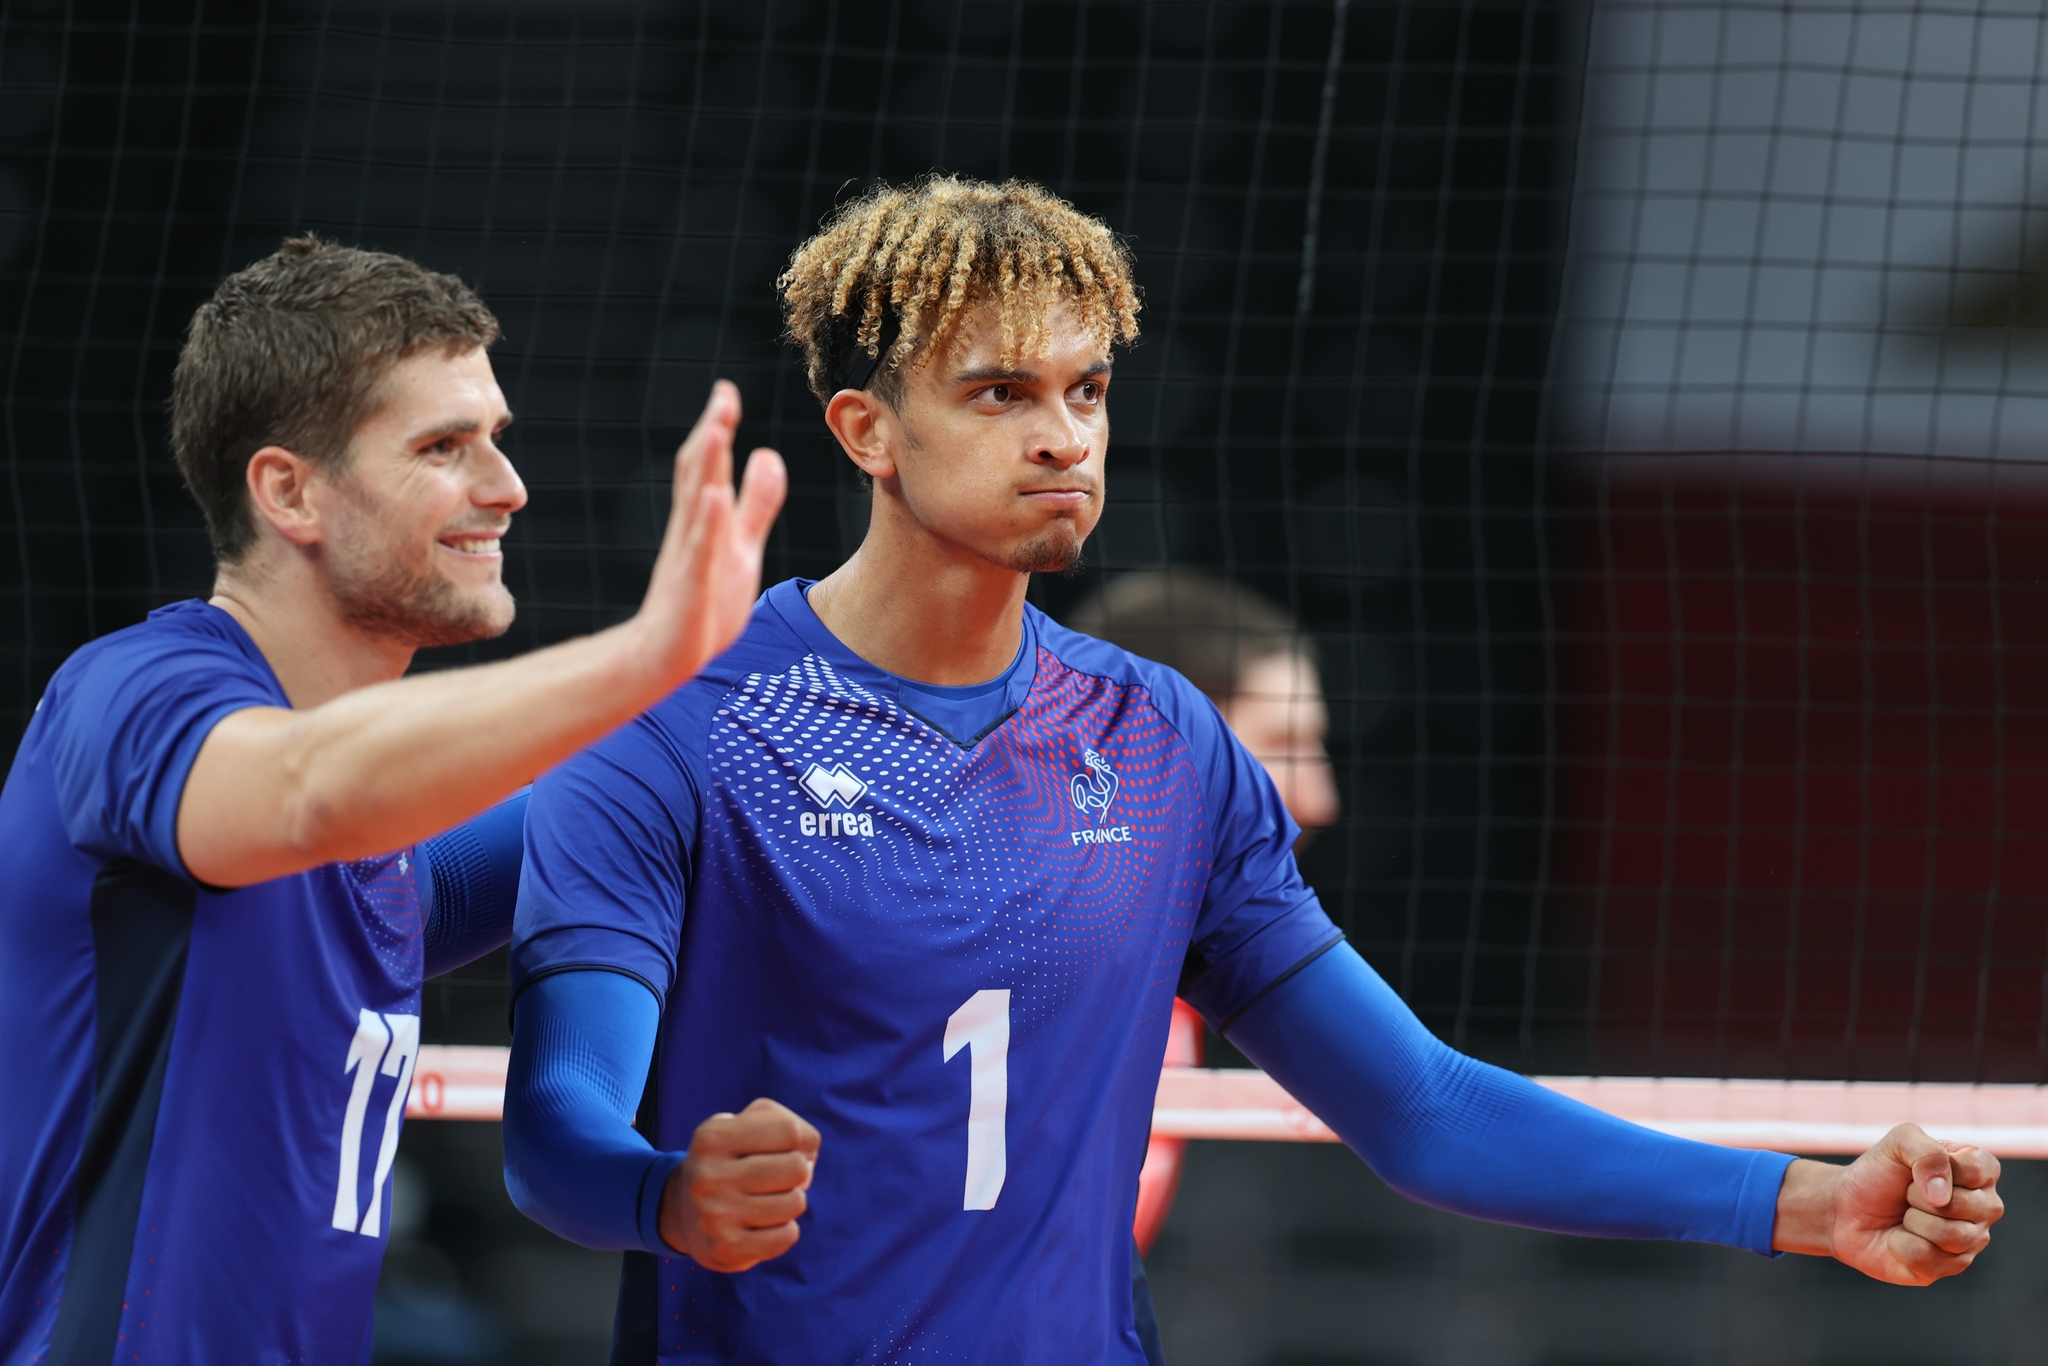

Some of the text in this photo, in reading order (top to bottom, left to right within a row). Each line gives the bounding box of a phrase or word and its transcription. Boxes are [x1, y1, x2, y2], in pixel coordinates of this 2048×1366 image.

[1071, 826, 1132, 846] FRANCE
[332, 1007, 420, 1238] 17
[943, 989, 1011, 1211] 1
